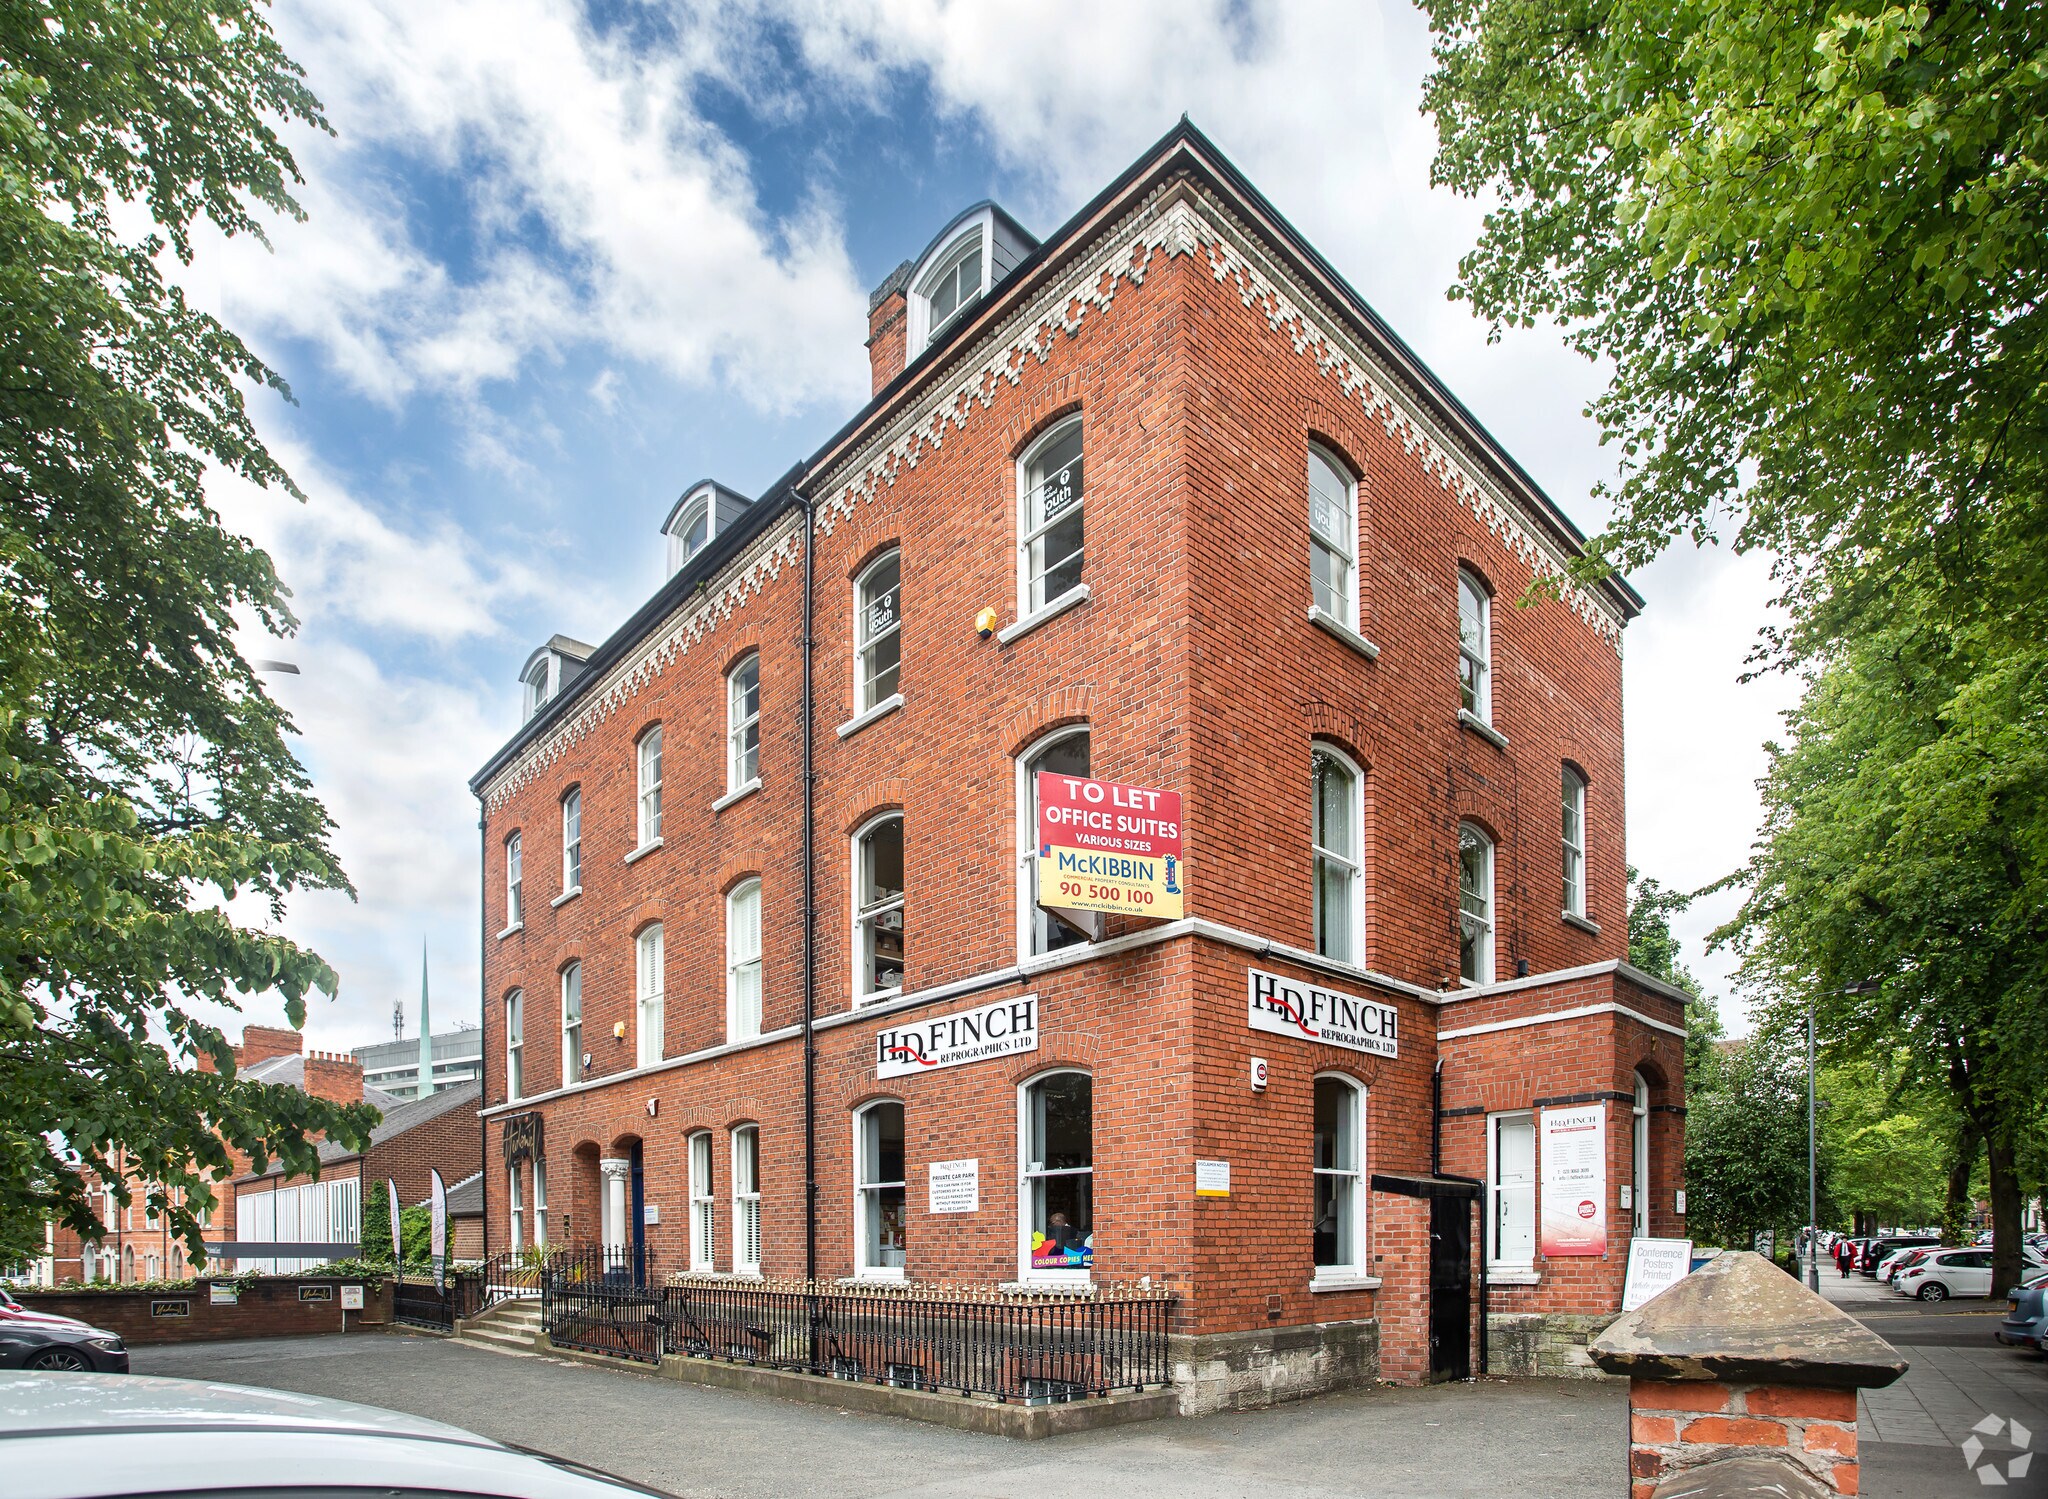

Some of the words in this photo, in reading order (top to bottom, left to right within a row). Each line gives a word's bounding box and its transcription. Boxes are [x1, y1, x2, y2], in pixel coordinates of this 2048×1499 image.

[869, 609, 892, 633] youth
[1063, 779, 1104, 802] TO
[1112, 787, 1161, 811] LET
[1046, 806, 1112, 830] OFFICE
[1117, 815, 1178, 838] SUITES
[1076, 833, 1122, 848] VARIOUS
[1125, 840, 1151, 851] SIZES
[1059, 852, 1153, 881] McKIBBIN
[1060, 882, 1082, 896] 90
[1089, 885, 1120, 900] 500
[1127, 890, 1153, 904] 100
[1063, 874, 1093, 882] COMMERCIAL
[1118, 880, 1149, 888] CONSULTANTS
[1071, 900, 1143, 912] www.mckibbin.co.uk
[928, 1000, 1034, 1051] FINCH
[1309, 990, 1398, 1039] FINCH
[940, 1041, 1010, 1063] REPROGRAPHICS
[1014, 1036, 1031, 1048] LTD
[1322, 1028, 1380, 1050] REPROGRAPHICS
[1383, 1042, 1395, 1053] LTD
[1637, 1247, 1683, 1258] Conference
[1643, 1259, 1673, 1269] Posters
[1643, 1270, 1671, 1280] Printed
